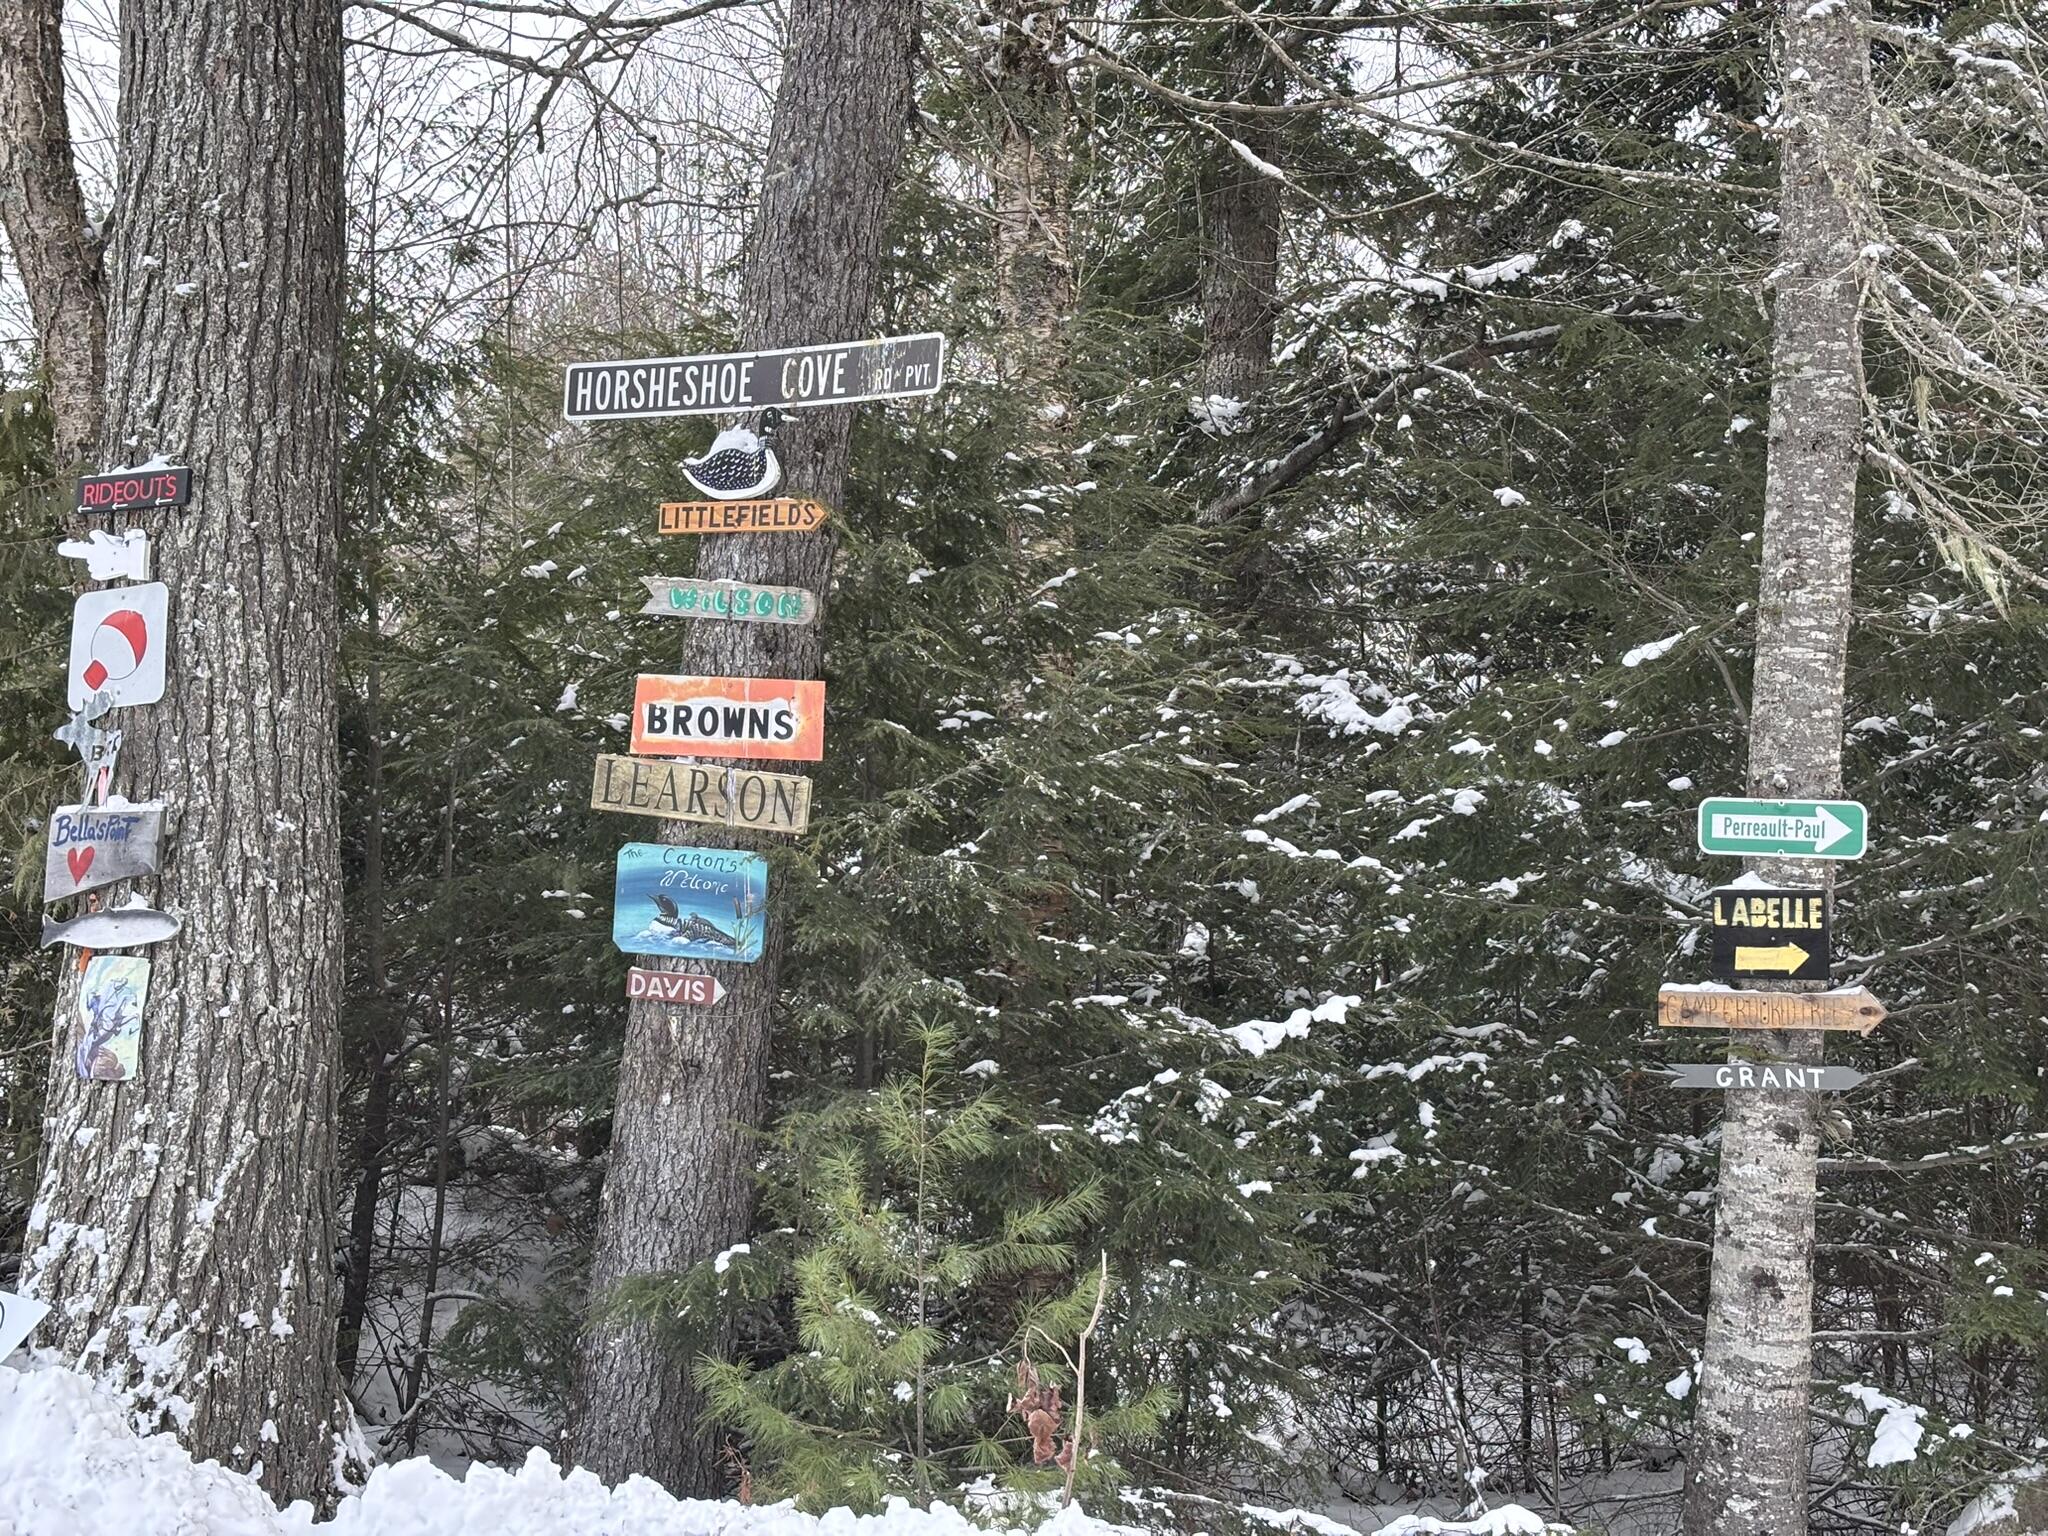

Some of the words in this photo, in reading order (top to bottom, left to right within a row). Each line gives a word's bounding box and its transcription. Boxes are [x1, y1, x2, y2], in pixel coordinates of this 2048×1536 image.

[575, 360, 755, 413] HORSHESHOE
[780, 351, 849, 401] COVE
[874, 367, 893, 391] RD
[904, 363, 930, 388] PVT
[82, 474, 177, 507] RIDEOUT'S
[660, 502, 816, 530] LITTLEFIELDS
[647, 703, 795, 740] BROWNS
[600, 758, 799, 827] LEARSON
[1723, 816, 1826, 840] Perreault-Paul
[1713, 896, 1824, 930] LABELLE
[630, 973, 706, 1003] DAVIS
[1666, 994, 1718, 1025] CAMP
[1715, 1066, 1825, 1090] GRANT
